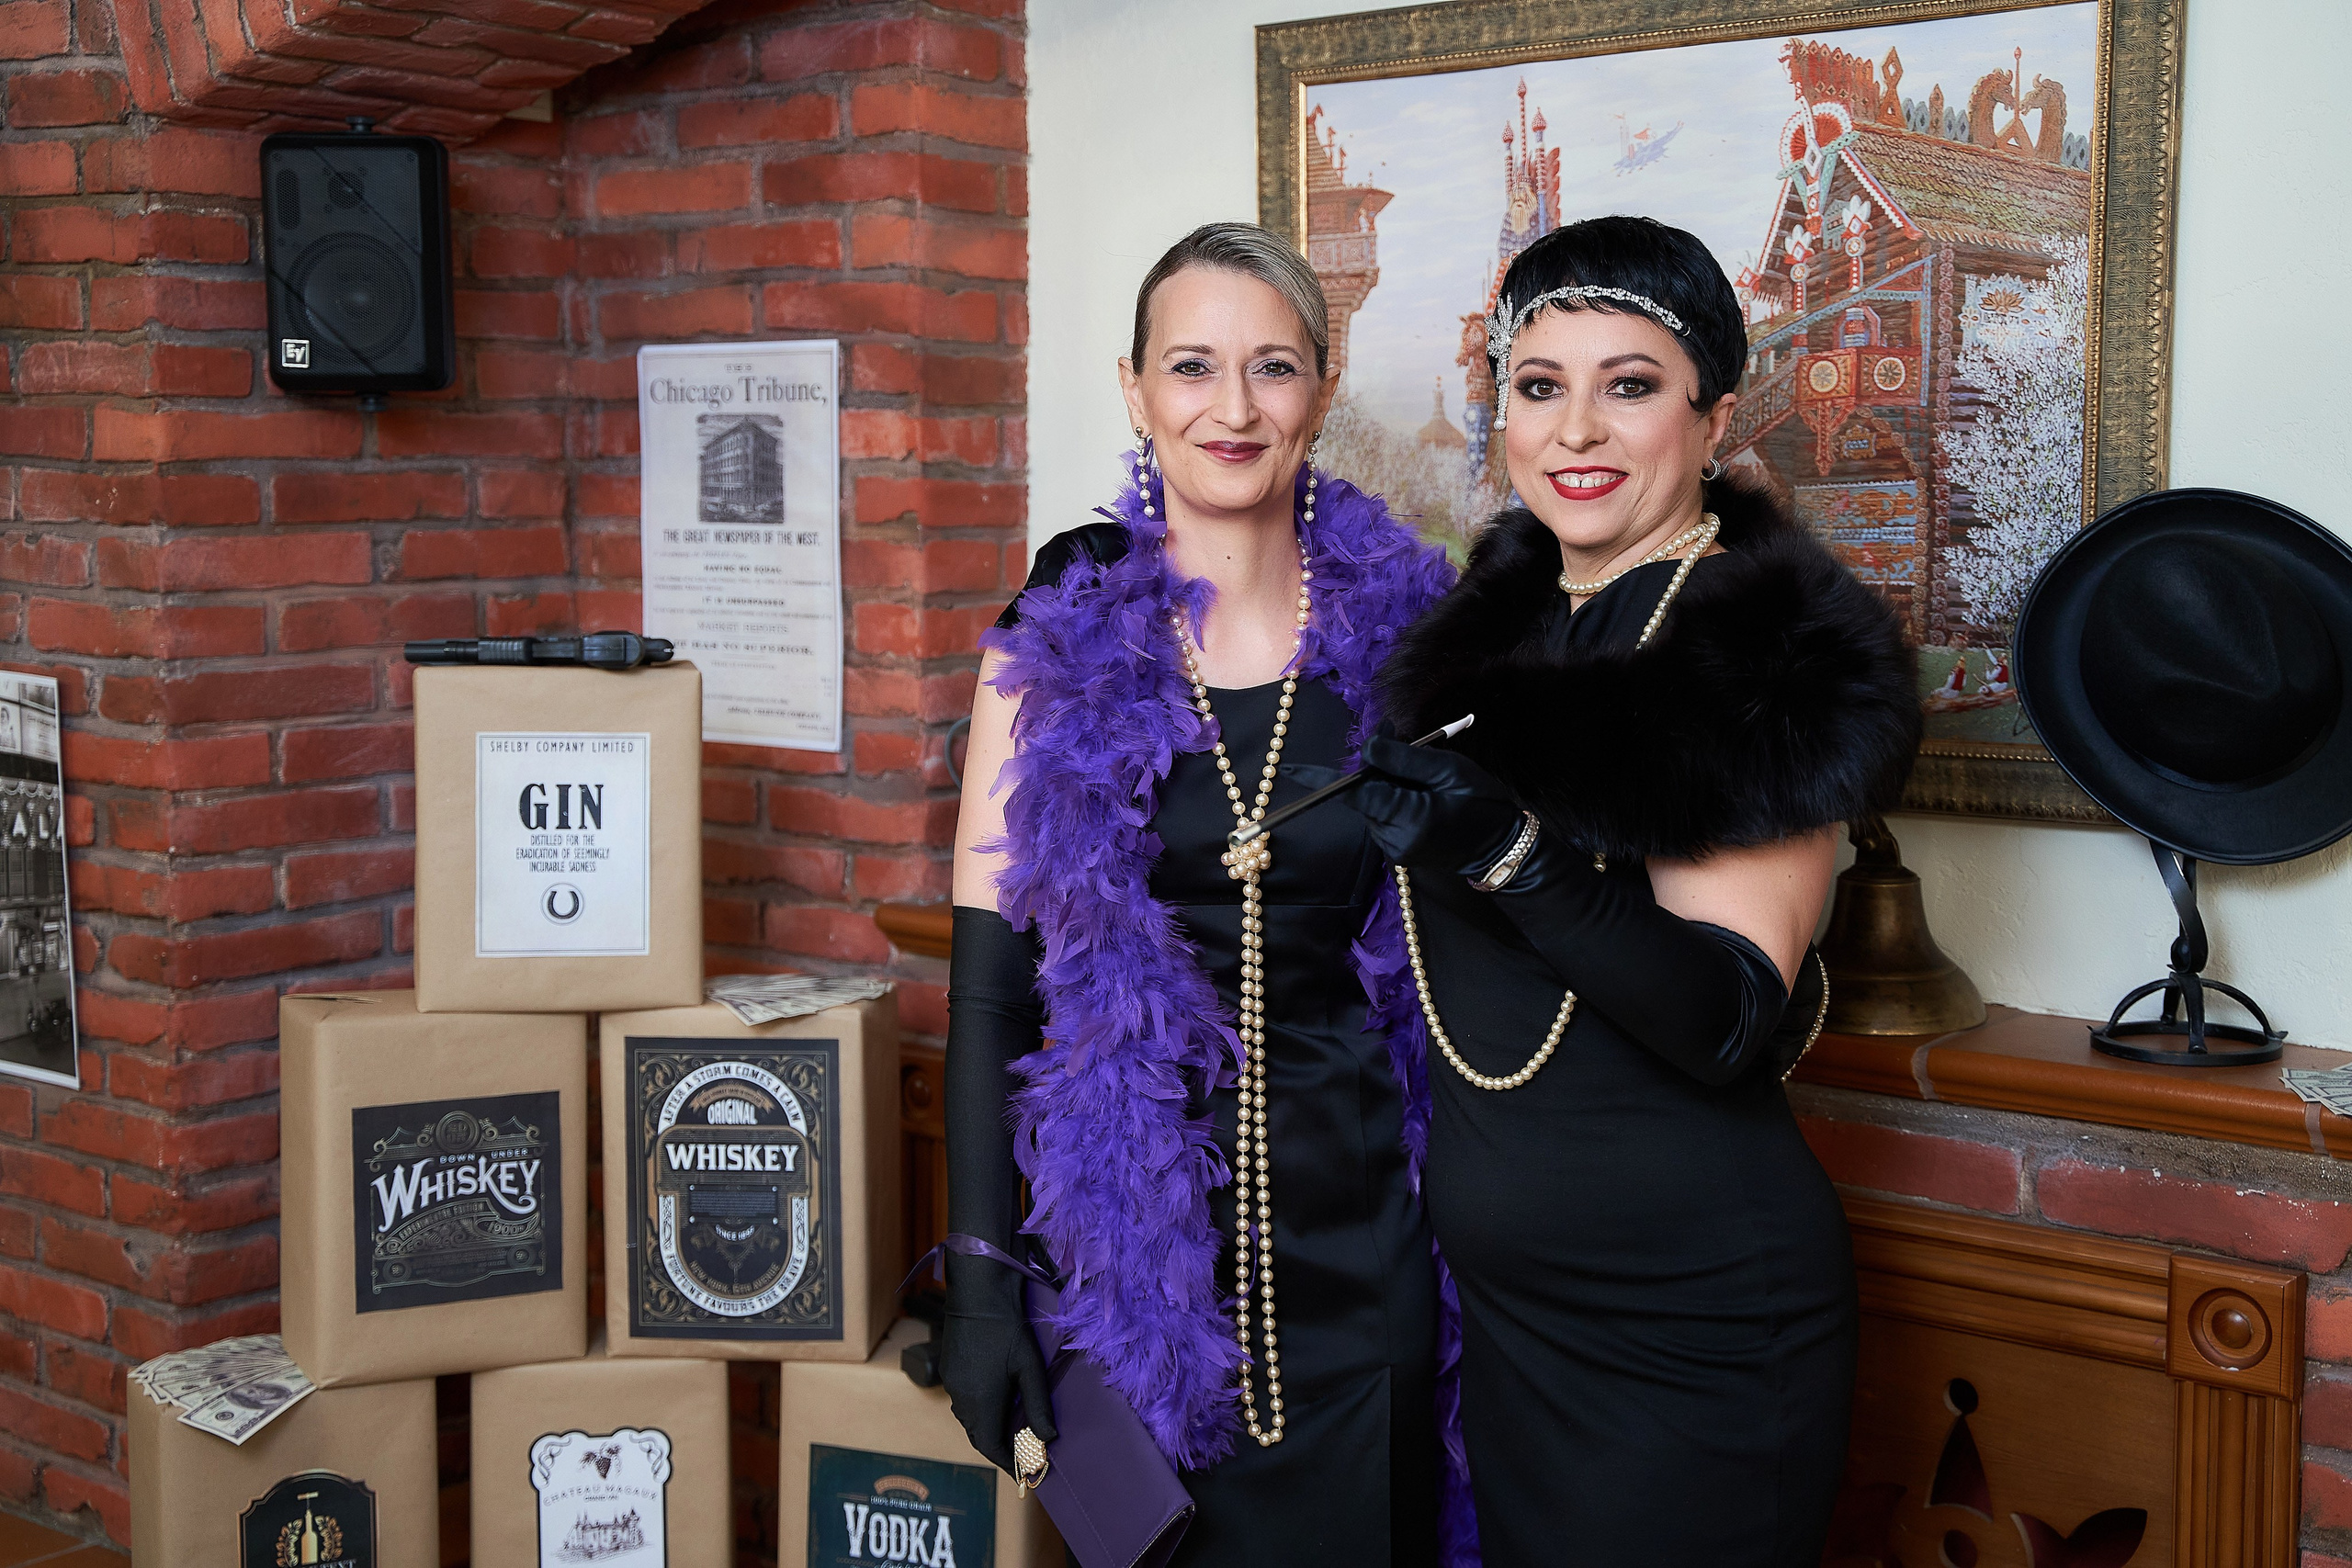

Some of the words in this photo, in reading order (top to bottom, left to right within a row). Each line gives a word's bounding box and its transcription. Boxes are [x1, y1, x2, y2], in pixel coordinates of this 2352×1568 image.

[286, 344, 305, 362] EV
[650, 378, 733, 411] Chicago
[738, 376, 828, 405] Tribune,
[662, 529, 679, 543] THE
[683, 529, 708, 544] GREAT
[713, 529, 760, 545] NEWSPAPER
[763, 530, 774, 545] OF
[777, 530, 792, 546] THE
[490, 740, 528, 753] SHELBY
[537, 741, 584, 753] COMPANY
[592, 741, 634, 753] LIMITED
[519, 784, 604, 830] GIN
[531, 834, 562, 845] DISTILLED
[566, 834, 579, 845] FOR
[582, 834, 594, 845] THE
[515, 848, 558, 860] ERADICATION
[561, 848, 570, 859] OF
[574, 848, 610, 859] SEEMINGLY
[529, 862, 565, 873] INCURABLE
[569, 862, 596, 873] SADNESS
[685, 1082, 694, 1090] A
[693, 1066, 731, 1083] STORM
[735, 1066, 772, 1086] COMES
[774, 1085, 781, 1093] A
[707, 1099, 758, 1125] ORIGINAL
[440, 1153, 476, 1164] DOWN
[491, 1147, 528, 1159] UNDER
[665, 1143, 799, 1172] WHISKEY
[370, 1155, 542, 1233] WHISKEY
[716, 1224, 737, 1241] SINCE
[690, 1260, 707, 1280] NEW
[752, 1262, 780, 1290] AVENUE
[704, 1296, 755, 1313] FAVOURS
[759, 1292, 779, 1306] THE
[779, 1258, 803, 1292] BRAVE
[842, 1502, 956, 1568] VODKA
